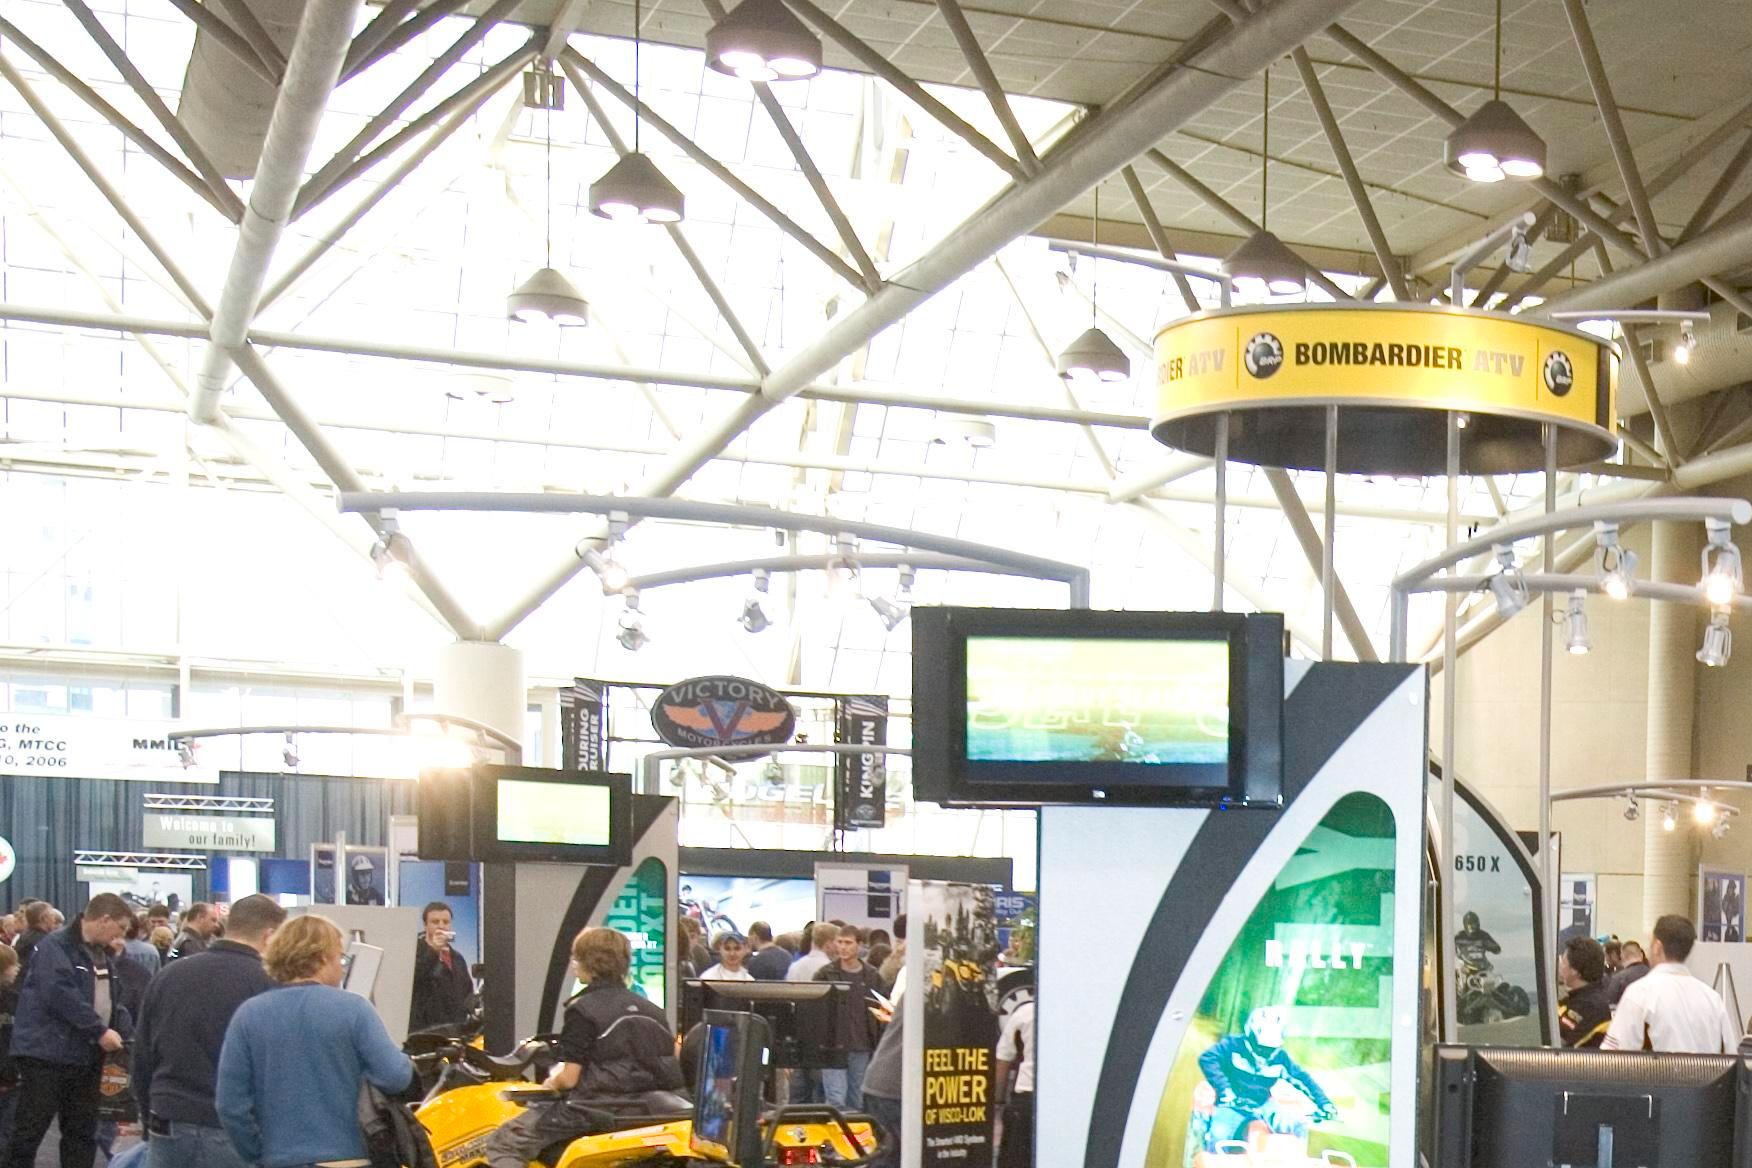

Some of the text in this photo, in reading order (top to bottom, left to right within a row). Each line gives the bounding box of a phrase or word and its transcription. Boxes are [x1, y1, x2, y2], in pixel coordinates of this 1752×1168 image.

[1189, 348, 1225, 376] ATV
[1294, 341, 1525, 378] BOMBARDIER ATV
[671, 681, 779, 709] VICTORY
[15, 723, 41, 735] the
[18, 739, 67, 752] MTCC
[26, 756, 68, 768] 2006
[160, 816, 234, 833] Welcome to
[189, 833, 256, 848] our family!
[1454, 855, 1500, 873] 650 X
[926, 1048, 989, 1072] FEEL THE
[926, 1074, 988, 1106] POWER
[925, 1109, 938, 1125] OF
